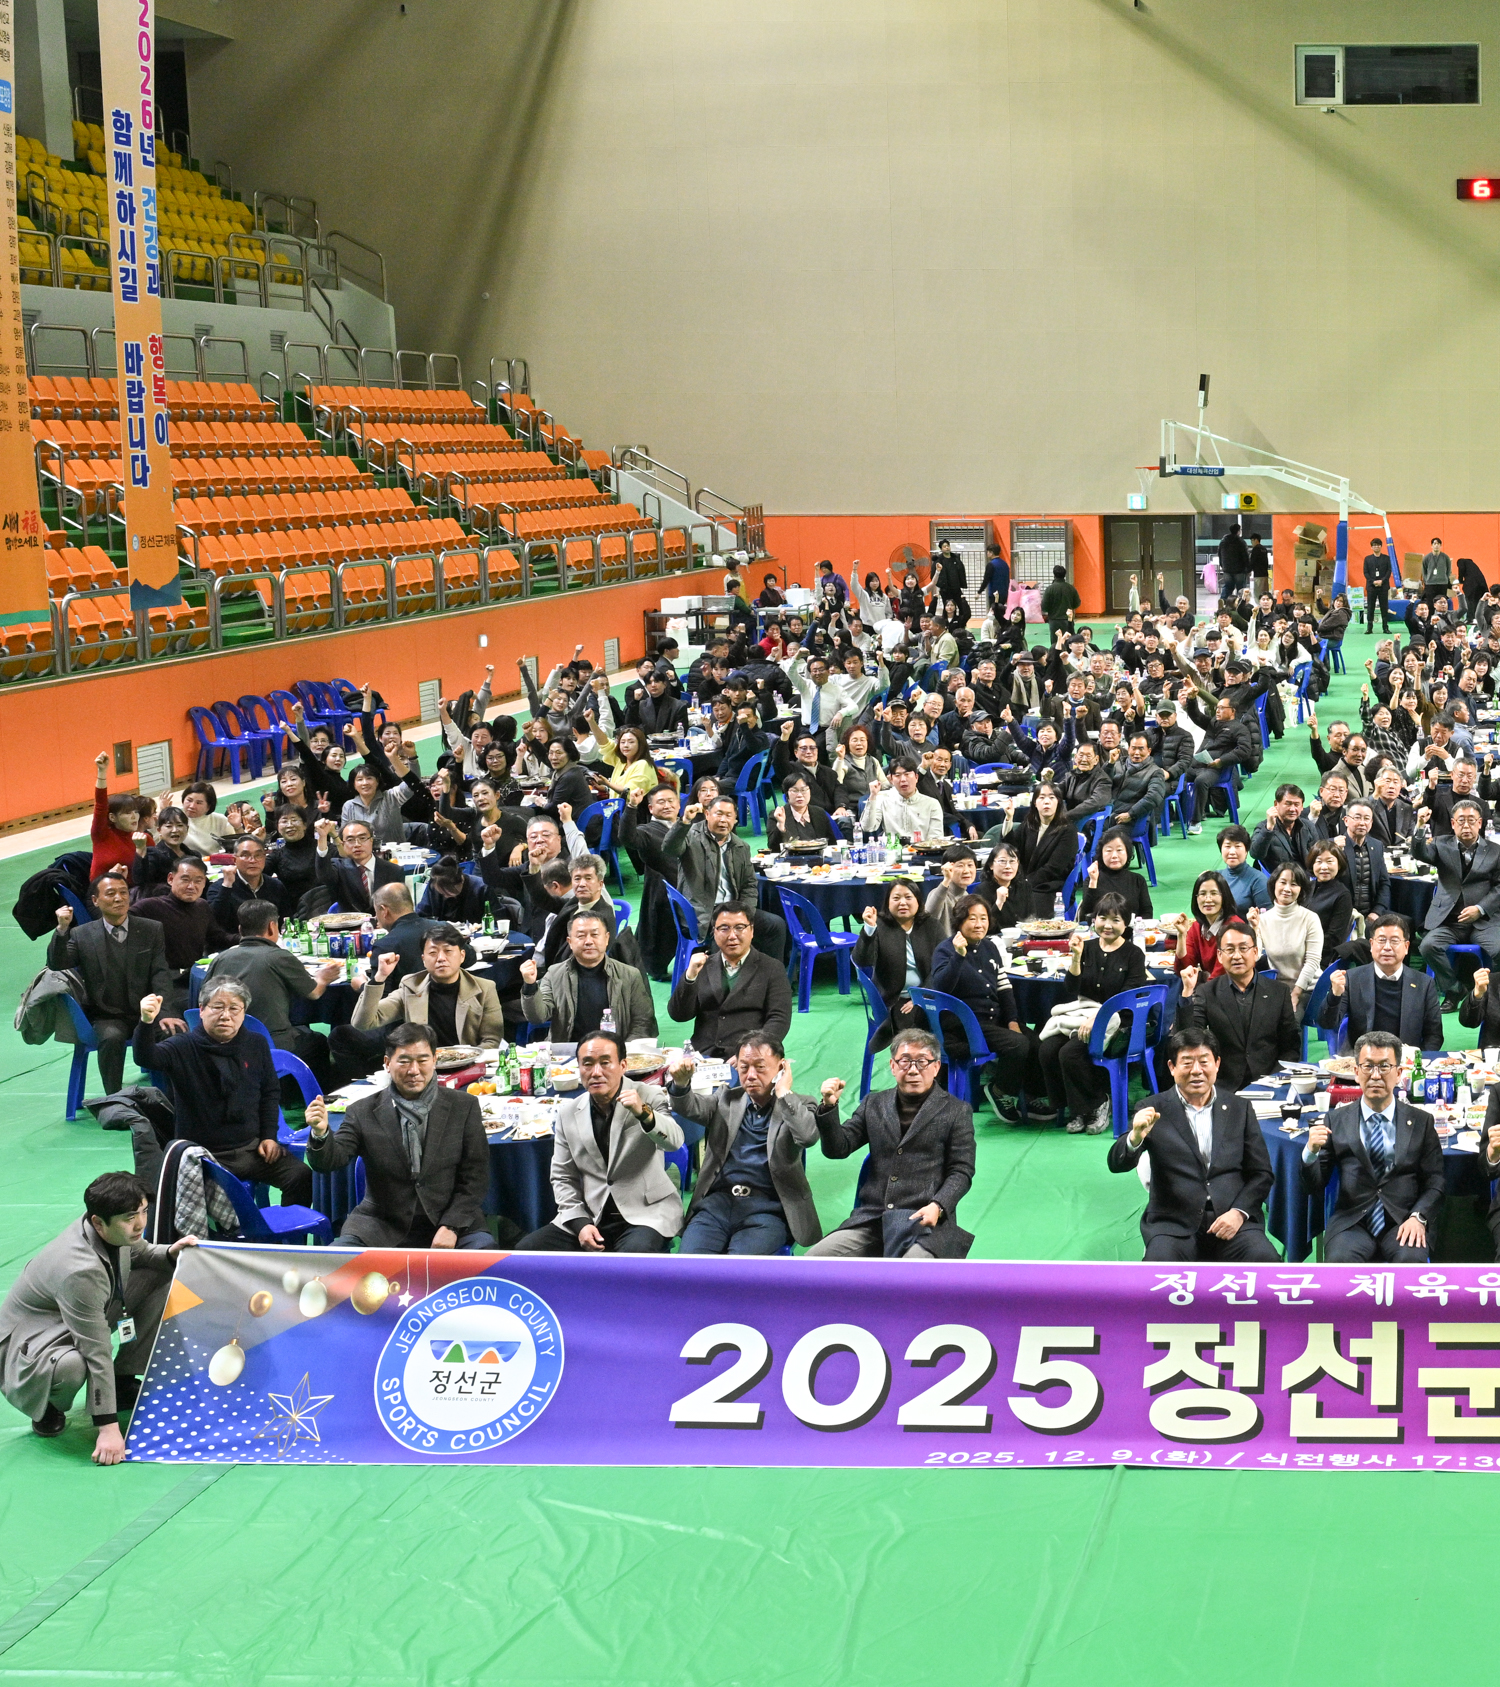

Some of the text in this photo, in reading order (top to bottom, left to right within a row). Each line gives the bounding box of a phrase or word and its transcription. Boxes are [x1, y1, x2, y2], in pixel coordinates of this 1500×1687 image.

[138, 0, 155, 168] 2026년
[1473, 180, 1490, 197] 6
[111, 109, 150, 487] 함께하시길 바랍니다
[395, 1286, 556, 1357] JEONGSEON COUNTY
[1151, 1271, 1321, 1306] 정선군
[429, 1370, 502, 1394] 정선군
[668, 1323, 1101, 1429] 2025
[382, 1377, 551, 1449] SPORTS COUNCIL
[924, 1451, 1025, 1464] 2025.
[1045, 1450, 1095, 1462] 12.
[1257, 1453, 1397, 1467] 식전행사
